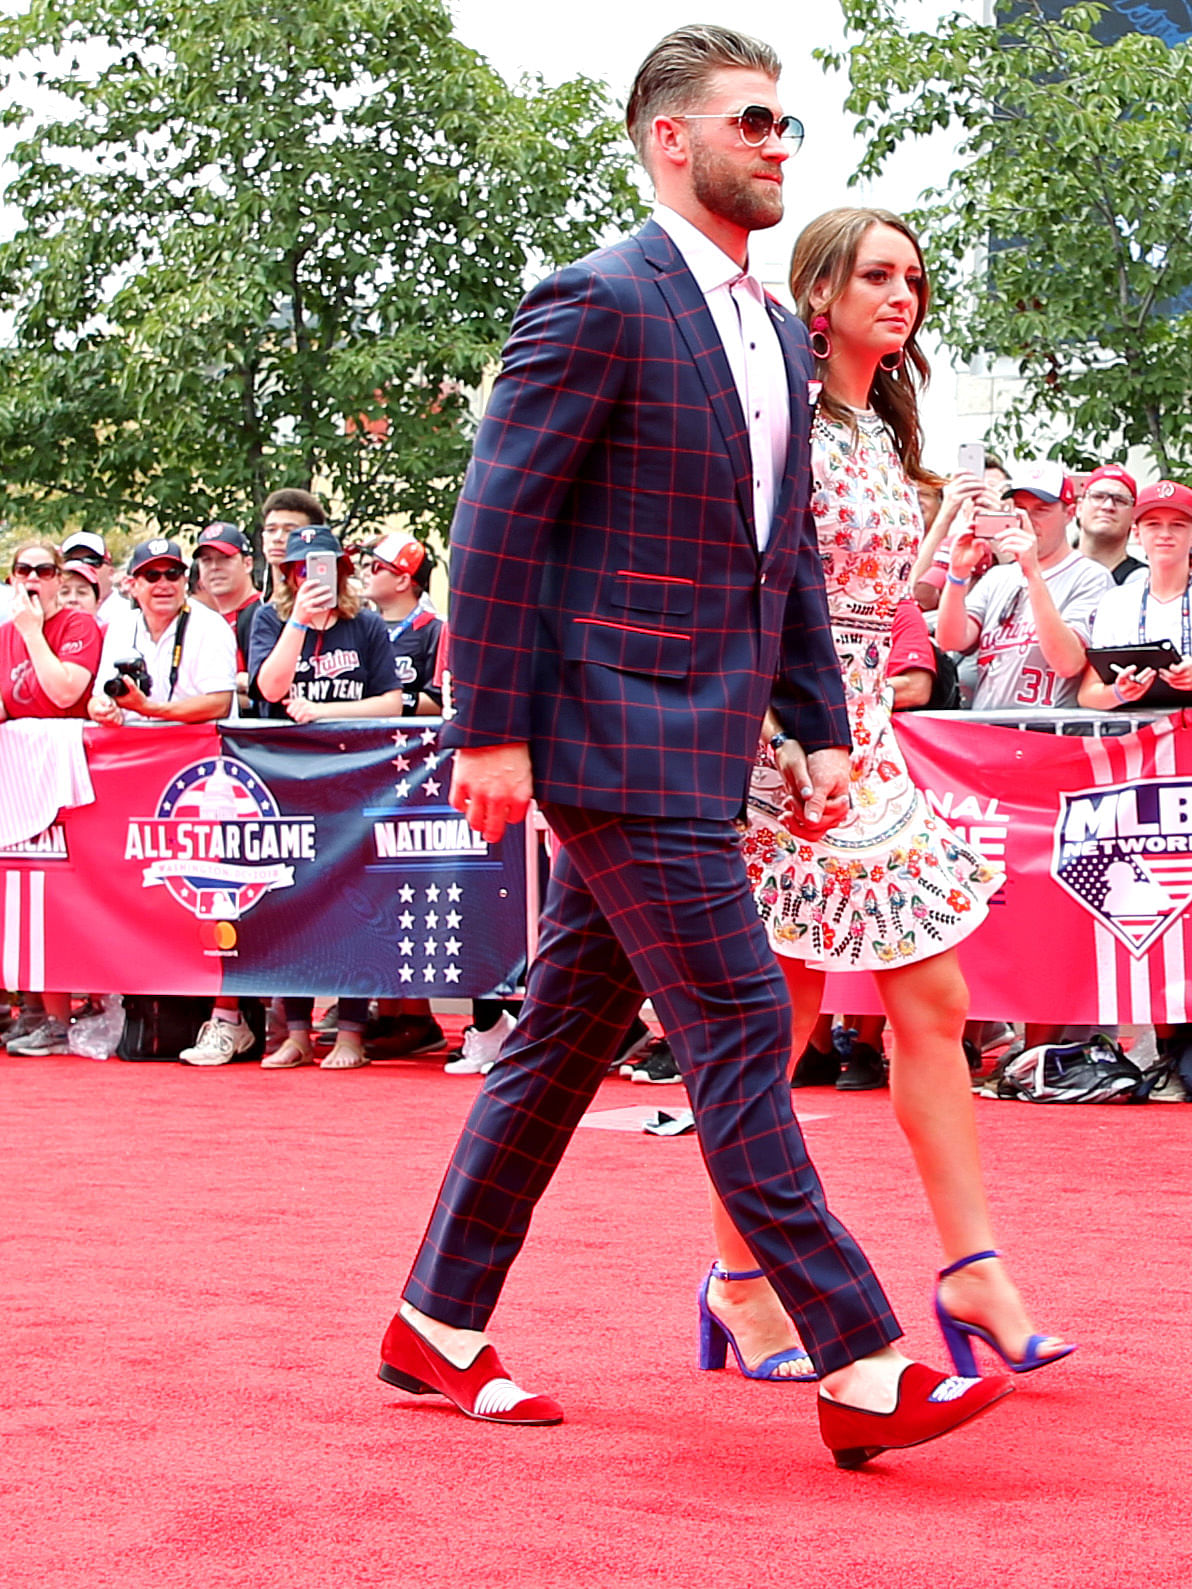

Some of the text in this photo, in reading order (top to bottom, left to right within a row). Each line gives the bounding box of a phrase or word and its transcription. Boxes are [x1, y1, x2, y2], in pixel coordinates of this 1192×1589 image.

[309, 679, 331, 699] MY
[333, 679, 364, 700] TEAM
[1016, 667, 1057, 707] 31
[124, 823, 316, 861] ALL STAR GAME
[374, 818, 488, 857] NATIONAL
